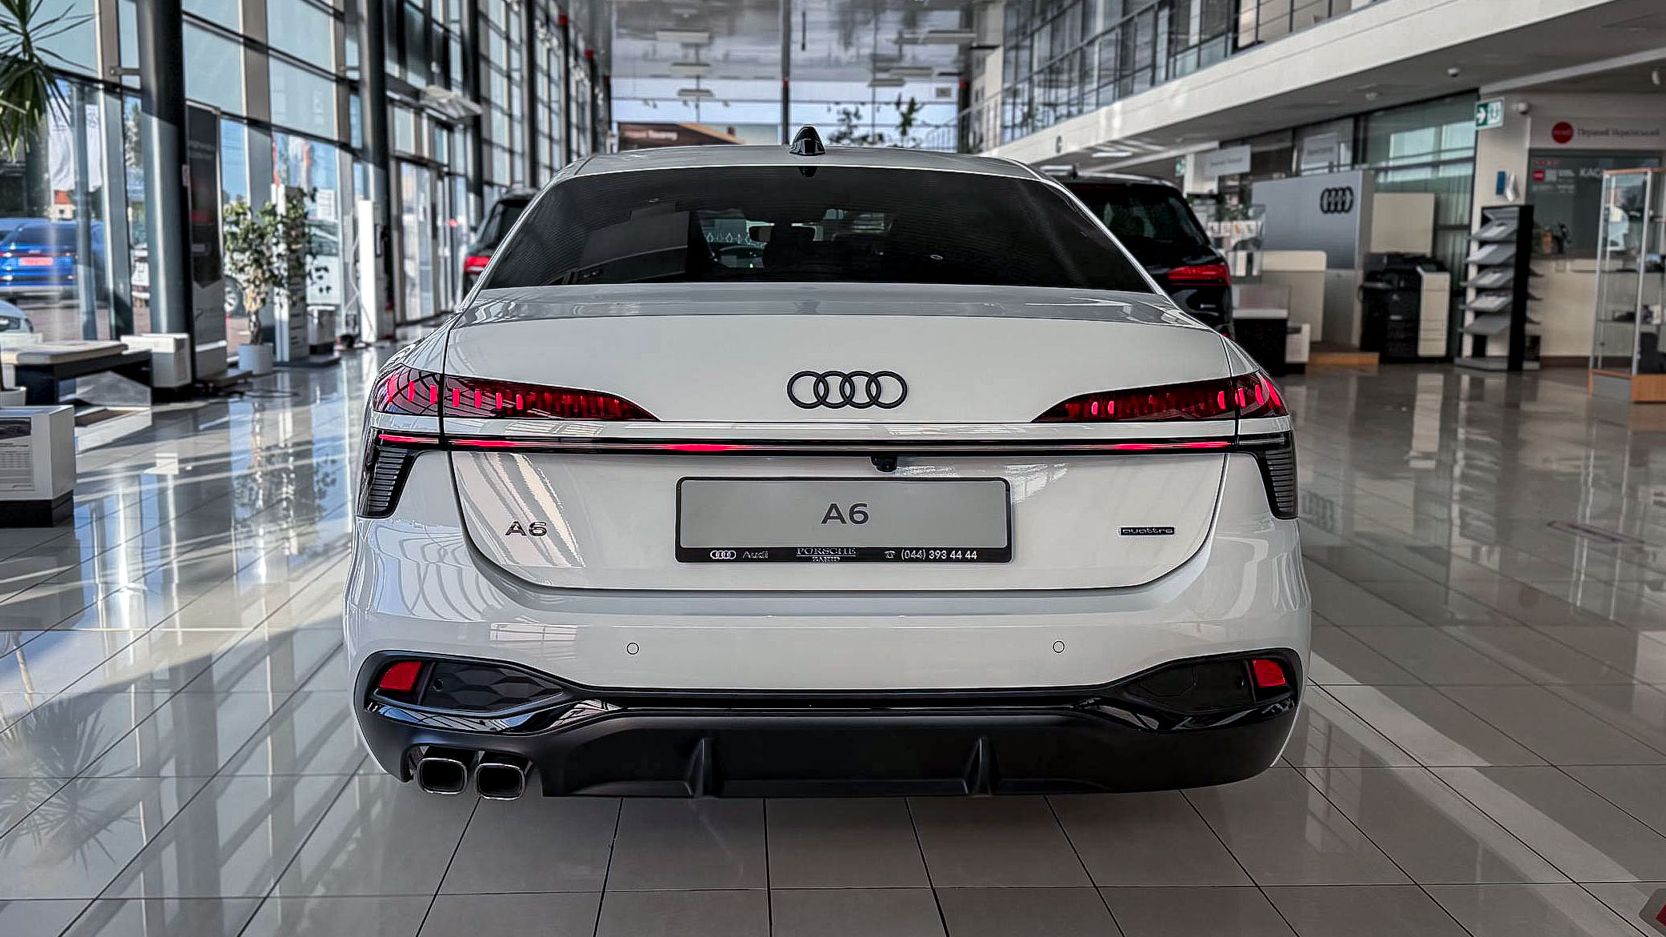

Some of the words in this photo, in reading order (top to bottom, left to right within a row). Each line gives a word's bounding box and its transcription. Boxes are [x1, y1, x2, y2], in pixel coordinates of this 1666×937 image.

[821, 503, 869, 525] A6
[505, 521, 548, 537] A6
[742, 550, 769, 559] Audi
[796, 547, 857, 555] PORSCHE
[901, 549, 926, 560] (044)
[928, 550, 947, 560] 393
[949, 550, 963, 560] 44
[964, 550, 978, 560] 44
